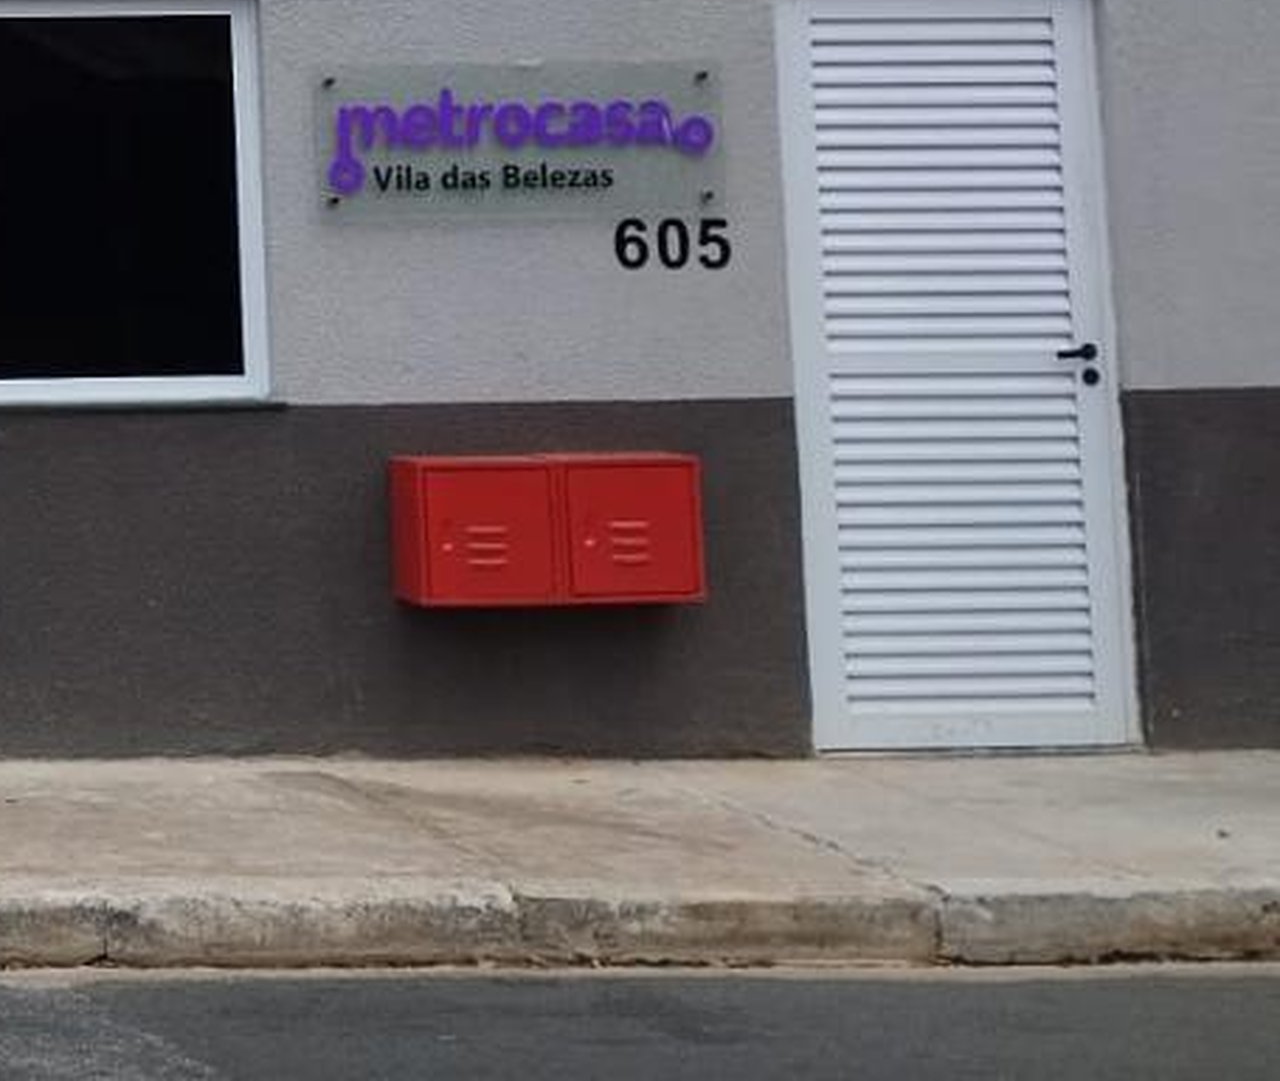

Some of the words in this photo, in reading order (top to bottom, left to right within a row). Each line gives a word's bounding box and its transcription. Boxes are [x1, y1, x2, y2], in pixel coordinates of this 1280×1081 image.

[328, 89, 713, 195] metrocasa
[373, 165, 430, 192] Vila
[440, 165, 491, 192] das
[502, 163, 614, 190] Belezas
[614, 219, 731, 269] 605
